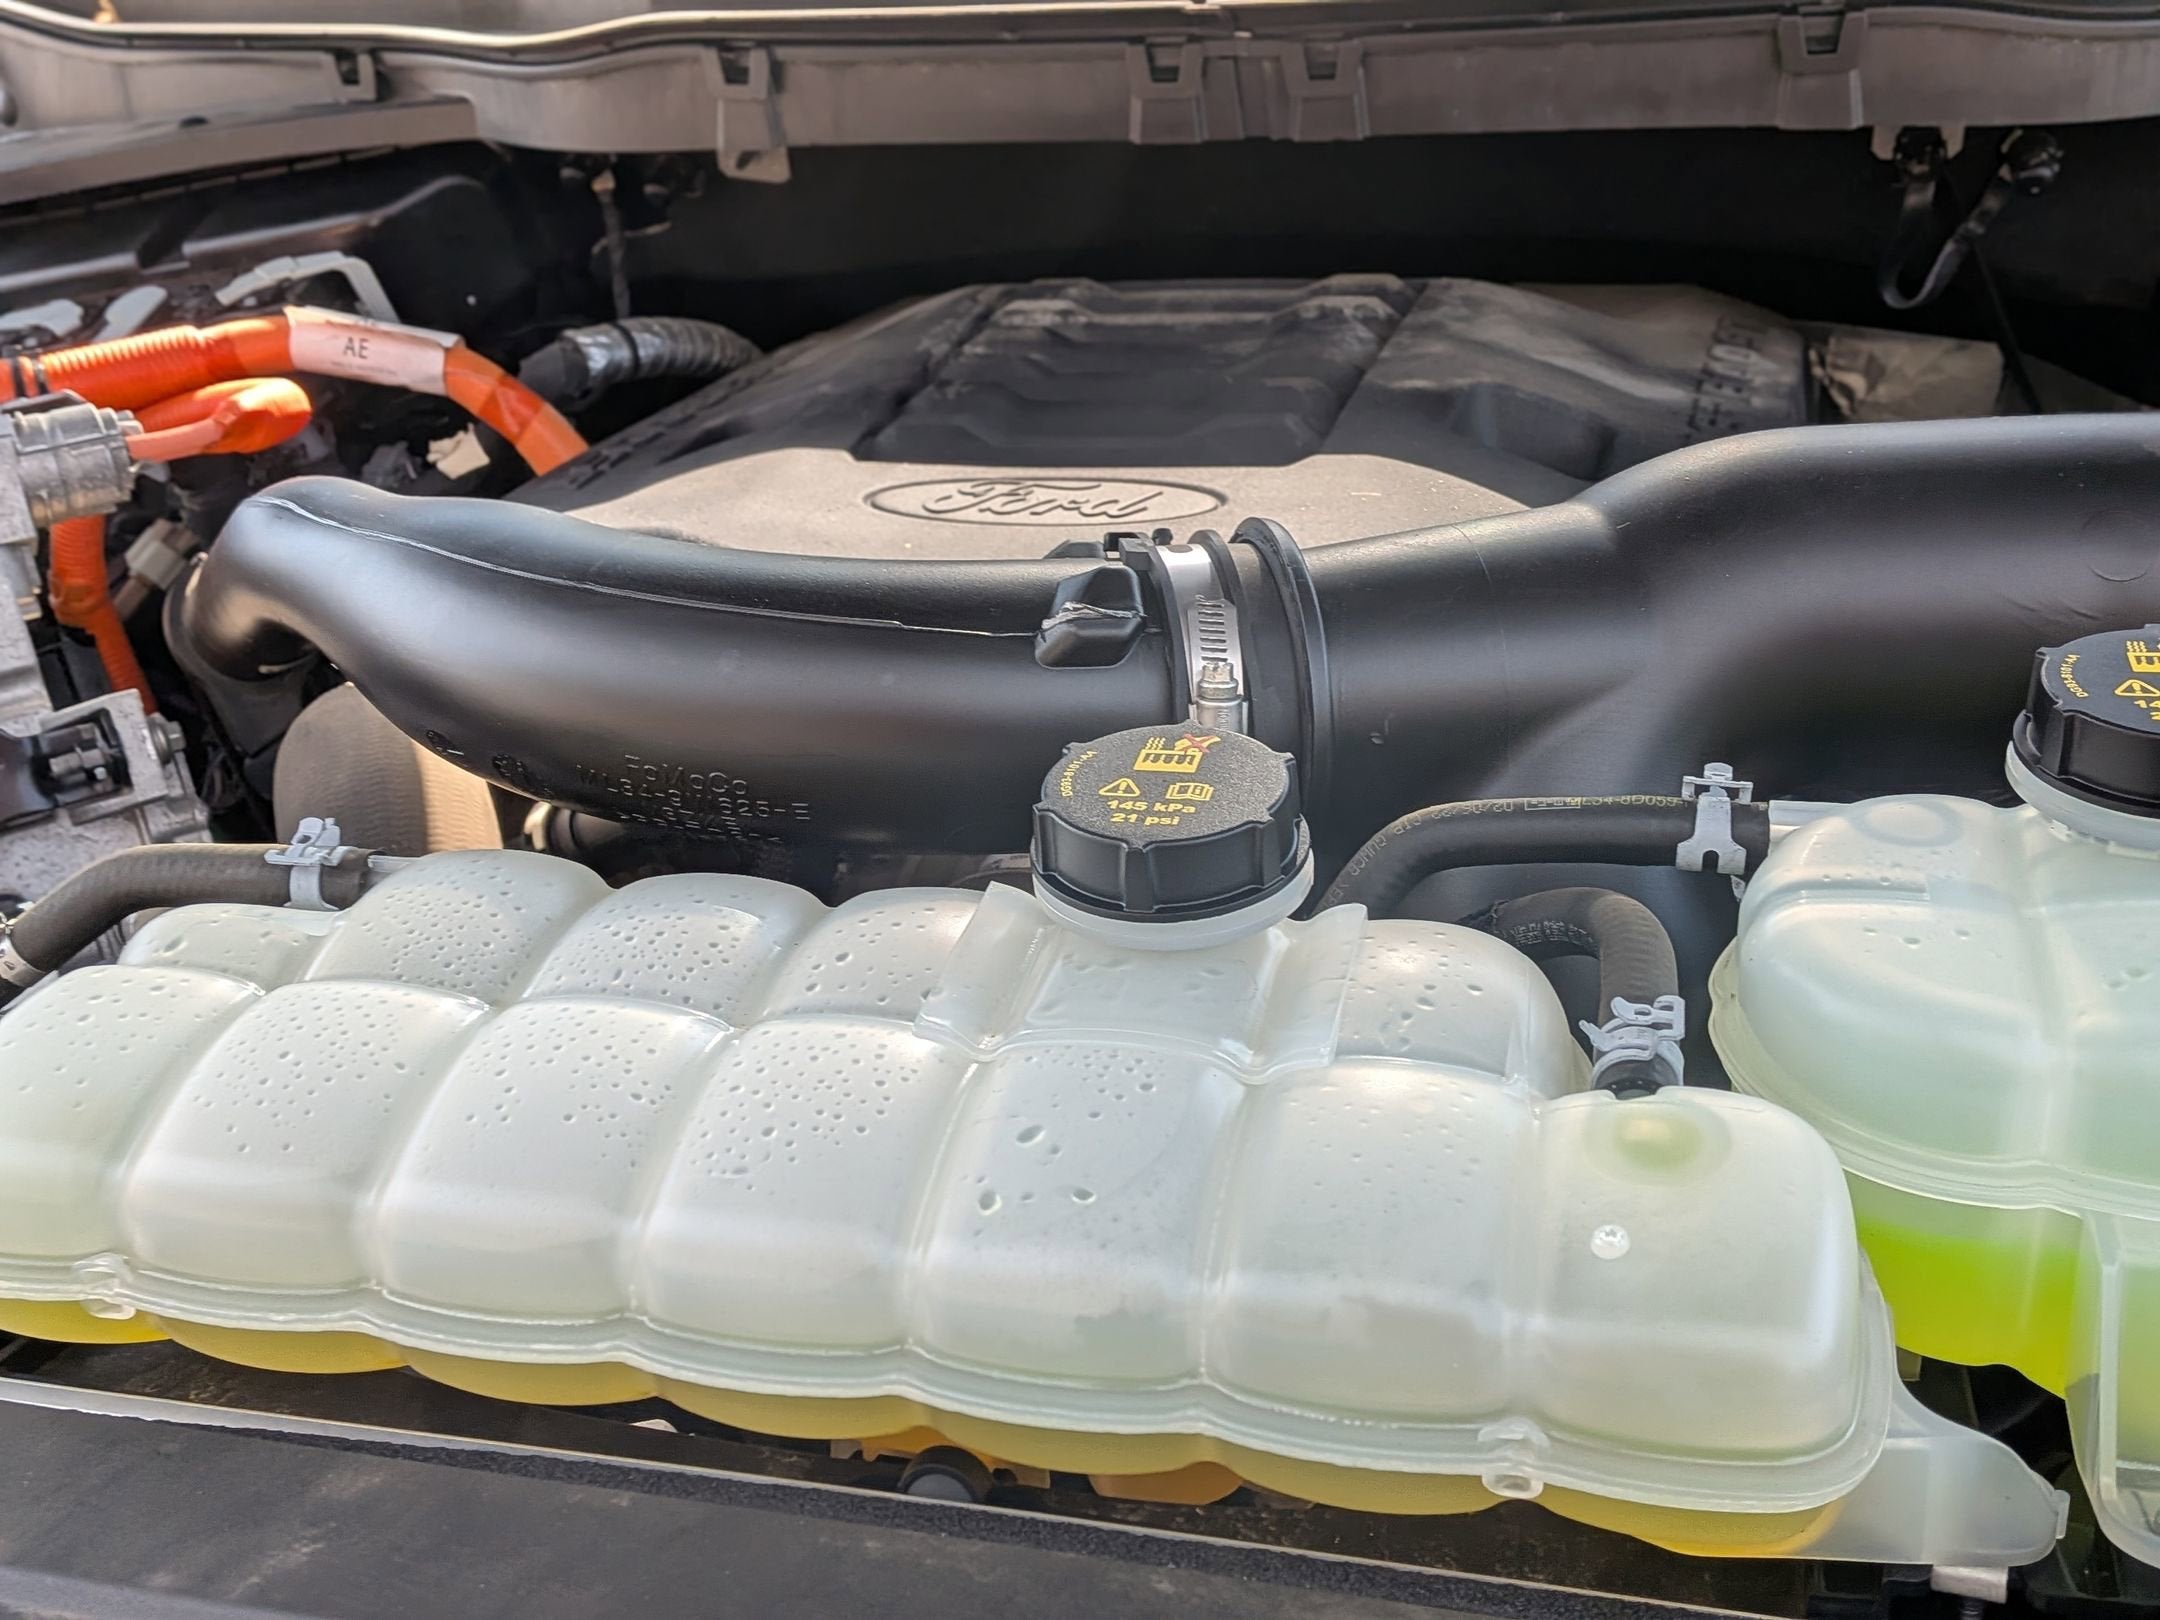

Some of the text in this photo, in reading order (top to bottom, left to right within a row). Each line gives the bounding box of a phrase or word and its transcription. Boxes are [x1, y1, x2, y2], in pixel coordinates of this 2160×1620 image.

[343, 337, 370, 359] AE
[921, 480, 1164, 518] Ford
[623, 753, 749, 796] FoMoCo
[1107, 800, 1197, 814] 145 kPa
[1110, 812, 1180, 827] 21 psi
